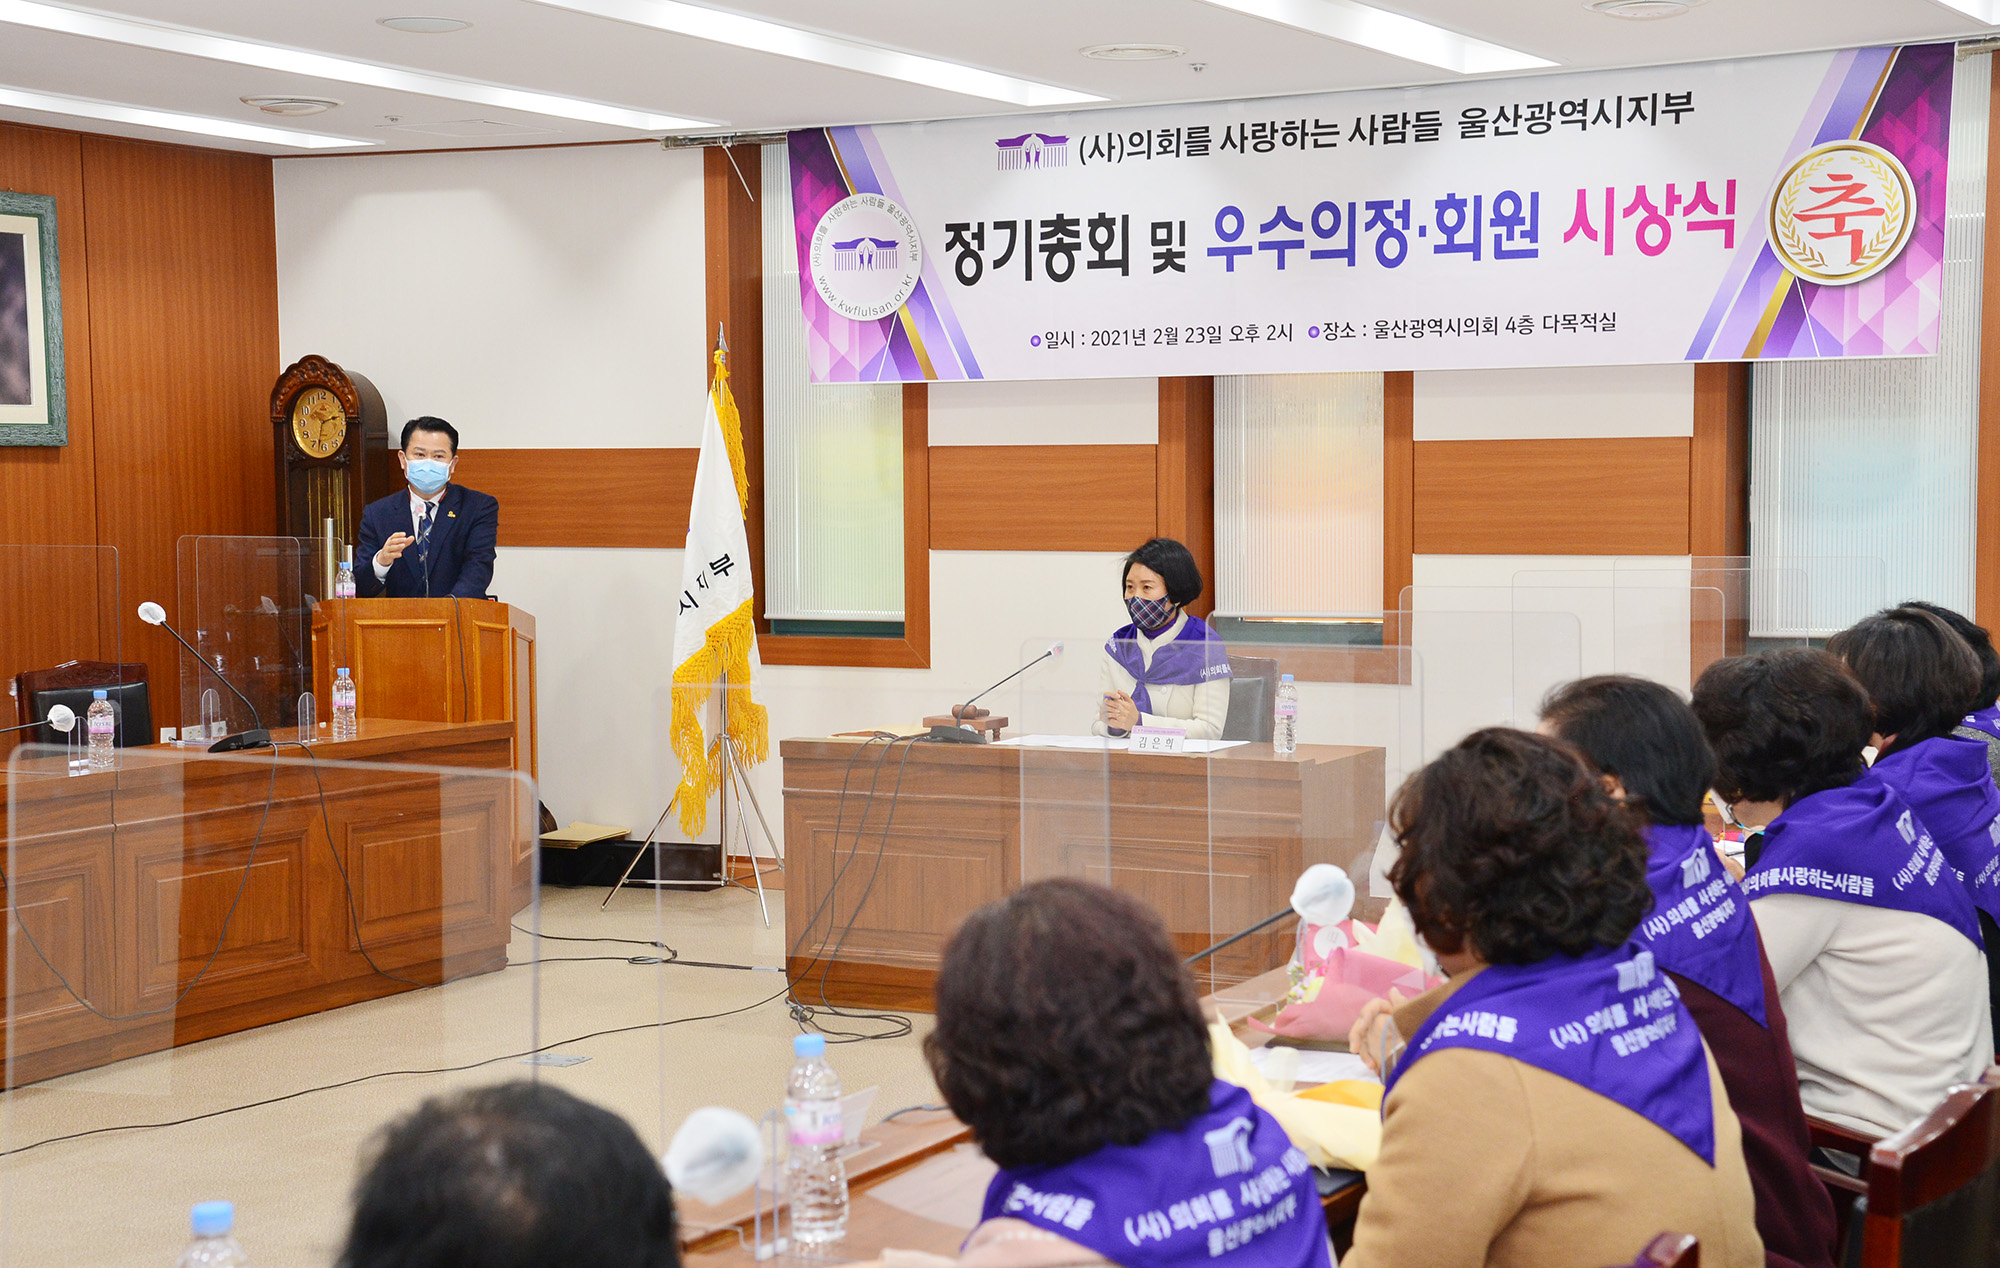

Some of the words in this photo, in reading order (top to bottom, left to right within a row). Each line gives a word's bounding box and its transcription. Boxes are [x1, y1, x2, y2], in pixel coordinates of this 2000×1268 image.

[1080, 126, 1212, 165] (사)의회를
[1220, 119, 1340, 154] 사랑하는
[1348, 111, 1442, 145] 사람들
[1458, 91, 1694, 139] 울산광역시지부
[945, 212, 1129, 286] 정기총회
[1151, 221, 1185, 274] 및
[1564, 179, 1736, 256] 시상식
[1792, 173, 1885, 264] 축
[1045, 331, 1074, 349] 일시
[1092, 328, 1145, 346] 2021년
[1154, 327, 1177, 345] 2월
[1186, 326, 1221, 344] 23일
[1229, 324, 1259, 343] 오후
[1267, 324, 1292, 342] 2시
[1323, 322, 1356, 341] 장소
[1374, 317, 1497, 339] 울산광역시의회
[1506, 315, 1534, 335] 4층
[1543, 312, 1615, 333] 다목적실
